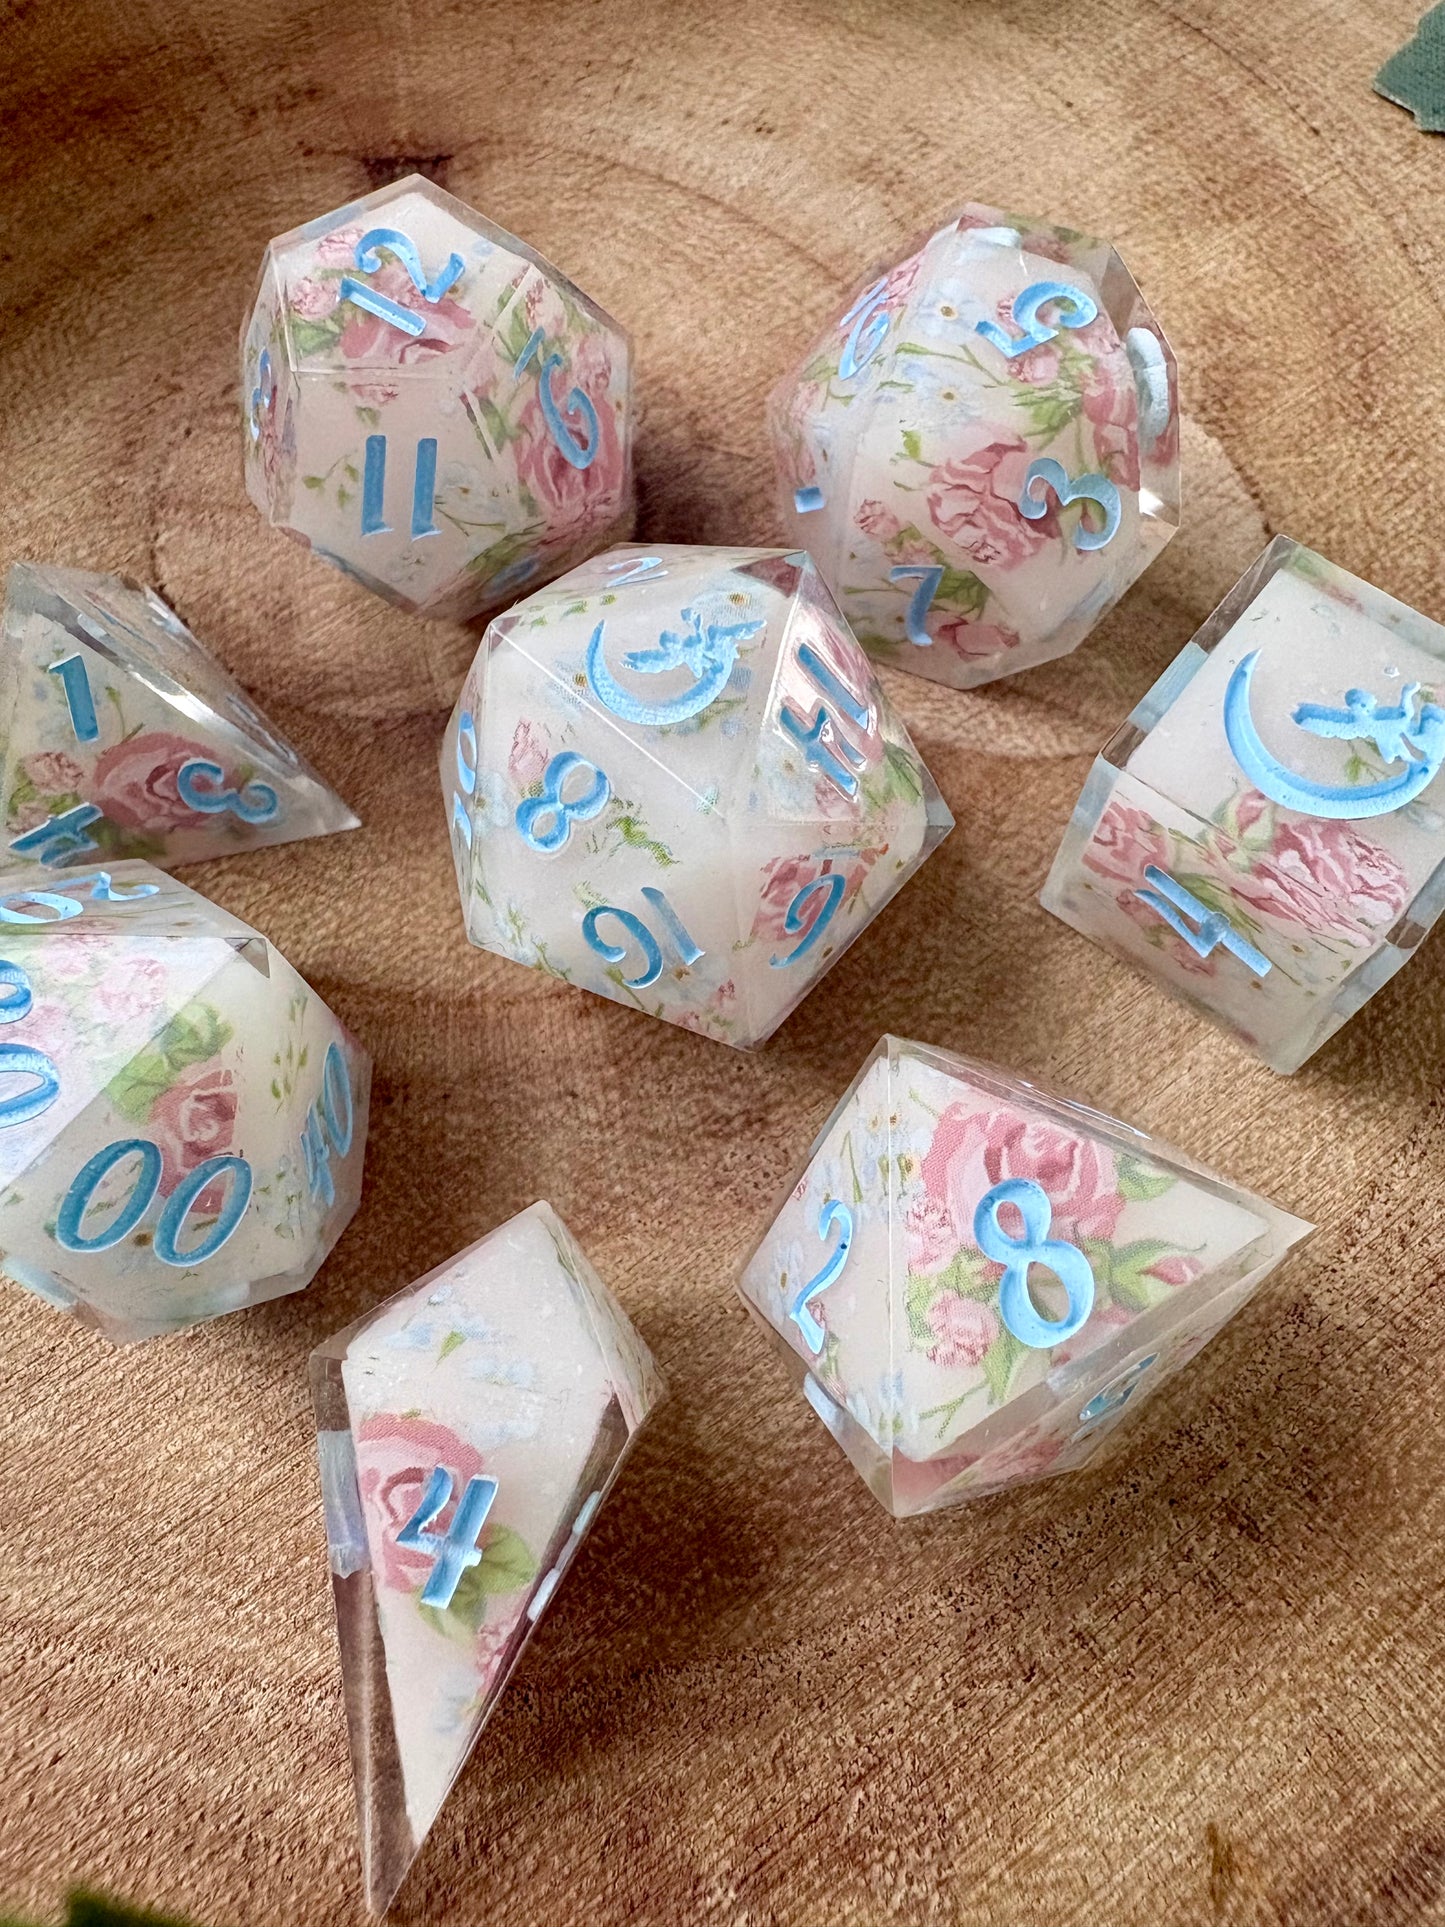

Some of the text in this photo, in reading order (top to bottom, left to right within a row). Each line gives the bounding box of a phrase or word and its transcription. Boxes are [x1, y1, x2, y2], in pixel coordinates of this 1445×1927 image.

[336, 228, 466, 337] 12
[975, 280, 1098, 359] 5
[361, 434, 443, 542] 11
[1018, 457, 1122, 552] 3
[889, 565, 945, 646] 7
[47, 651, 99, 744] 1
[176, 757, 279, 825] 3
[515, 750, 612, 854] 8
[56, 1138, 254, 1268] 00
[789, 1199, 854, 1355] 2
[973, 1177, 1096, 1349] 8
[395, 1463, 498, 1611] 4
